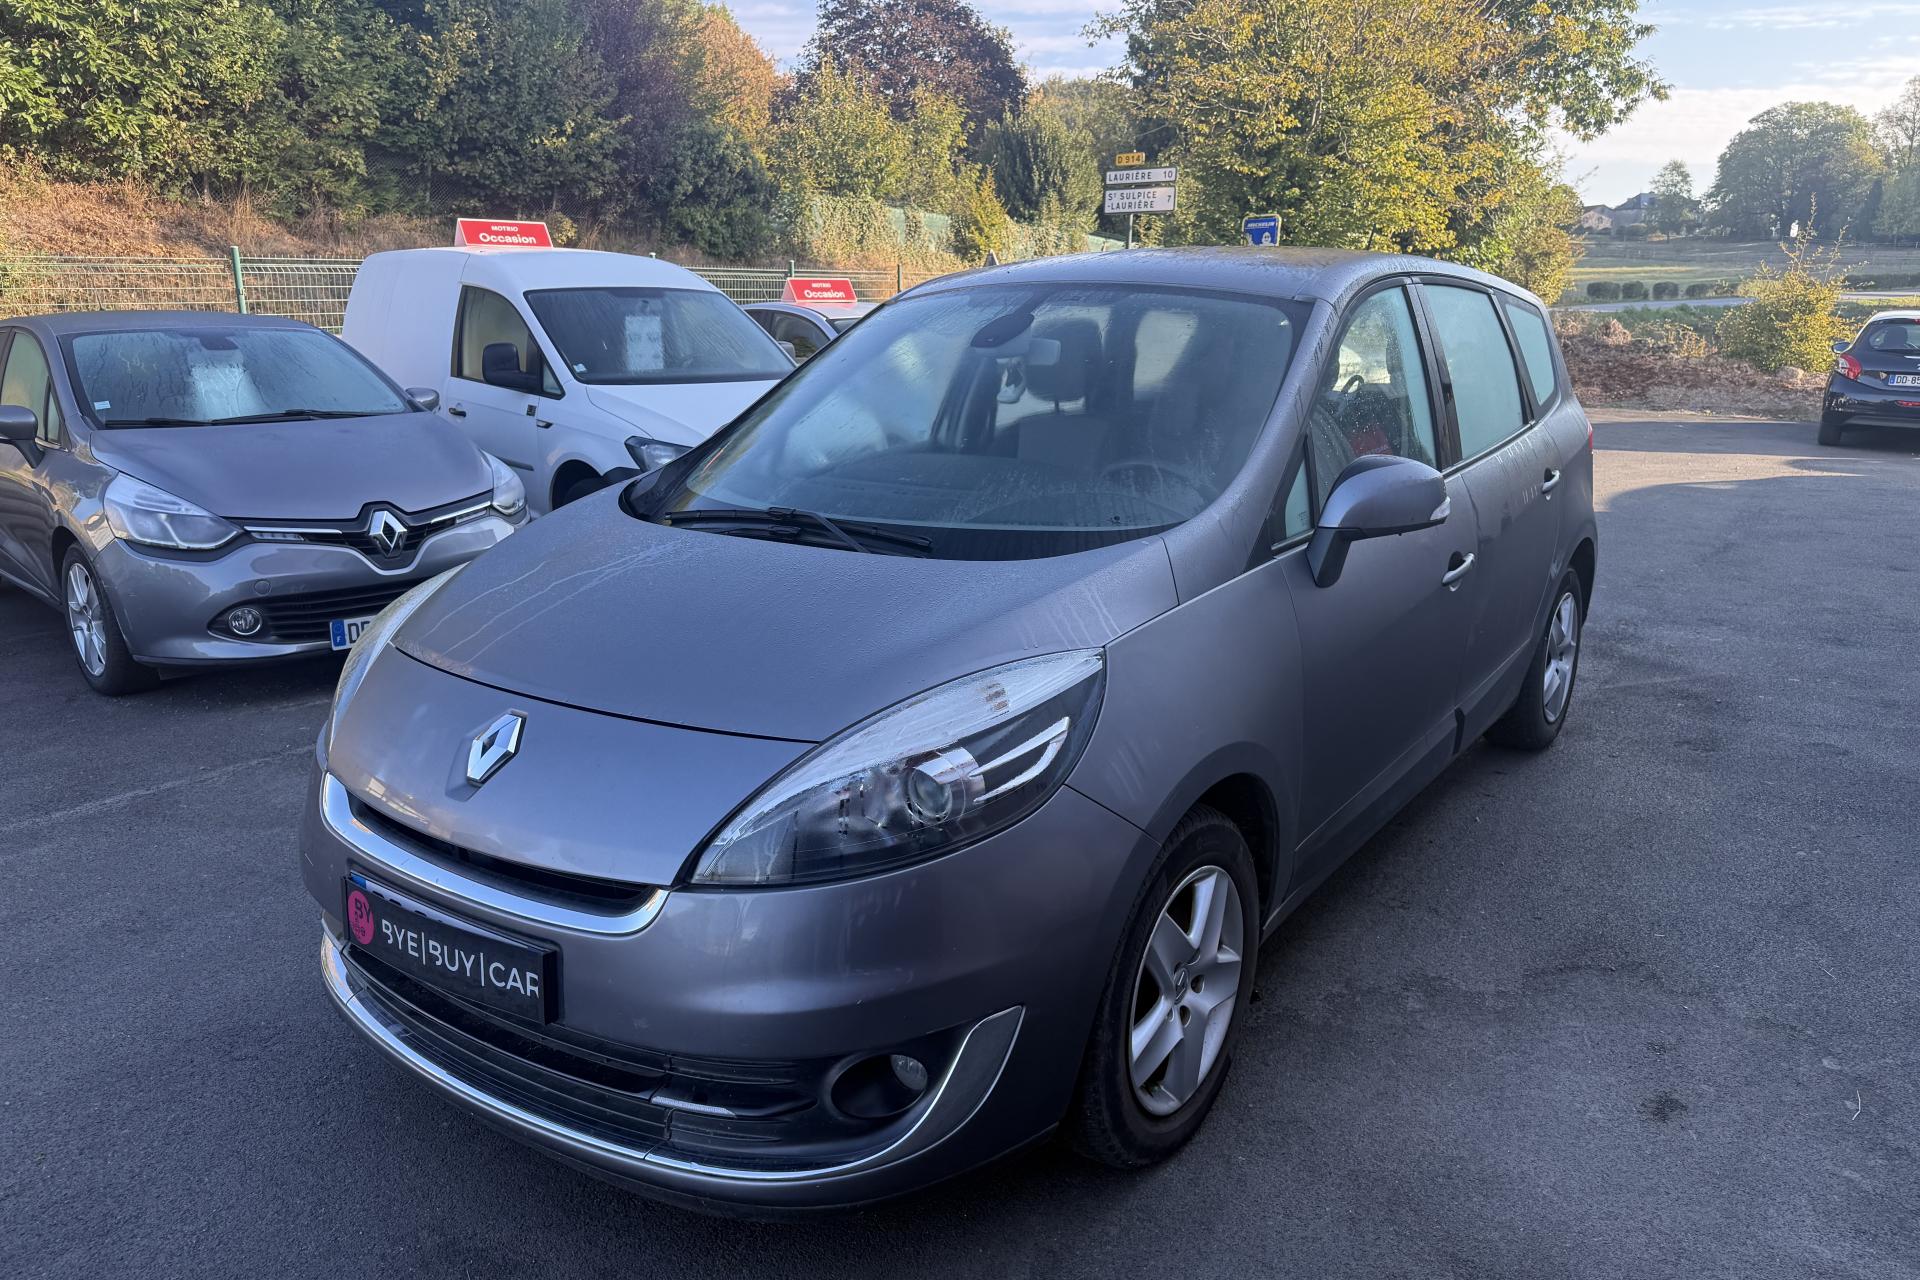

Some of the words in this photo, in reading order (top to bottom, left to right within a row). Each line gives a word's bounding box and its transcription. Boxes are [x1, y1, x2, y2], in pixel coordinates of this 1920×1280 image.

[1117, 156, 1123, 164] D
[1125, 155, 1141, 163] 914
[1163, 170, 1173, 178] 10
[1120, 191, 1157, 200] SULPICE
[1168, 195, 1172, 203] 7
[479, 232, 537, 244] Occasion
[804, 290, 846, 298] Occasion
